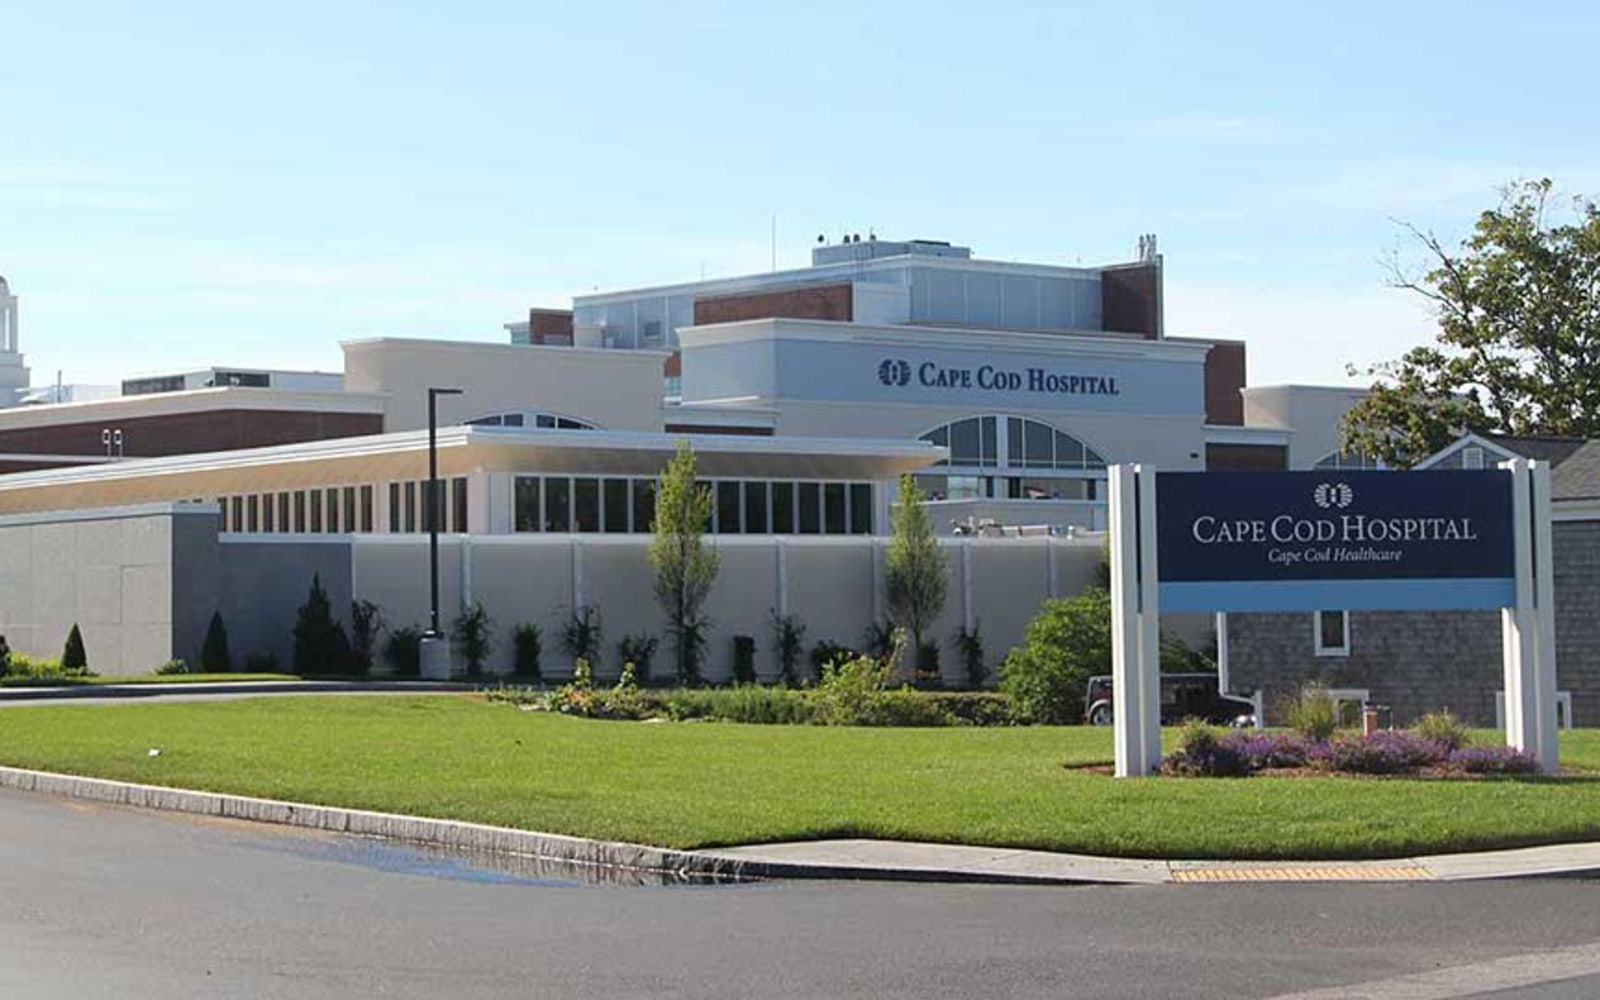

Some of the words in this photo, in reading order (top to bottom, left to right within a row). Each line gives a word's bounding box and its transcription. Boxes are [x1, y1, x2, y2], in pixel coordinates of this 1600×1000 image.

[918, 362, 972, 388] CAPE
[977, 365, 1022, 391] COD
[1027, 368, 1120, 395] HOSPITAL
[1193, 516, 1267, 543] CAPE
[1271, 515, 1335, 543] COD
[1340, 515, 1477, 542] HOSPITAL
[1268, 548, 1301, 565] Cape
[1305, 547, 1330, 562] Cod
[1333, 547, 1402, 562] Healthcare
